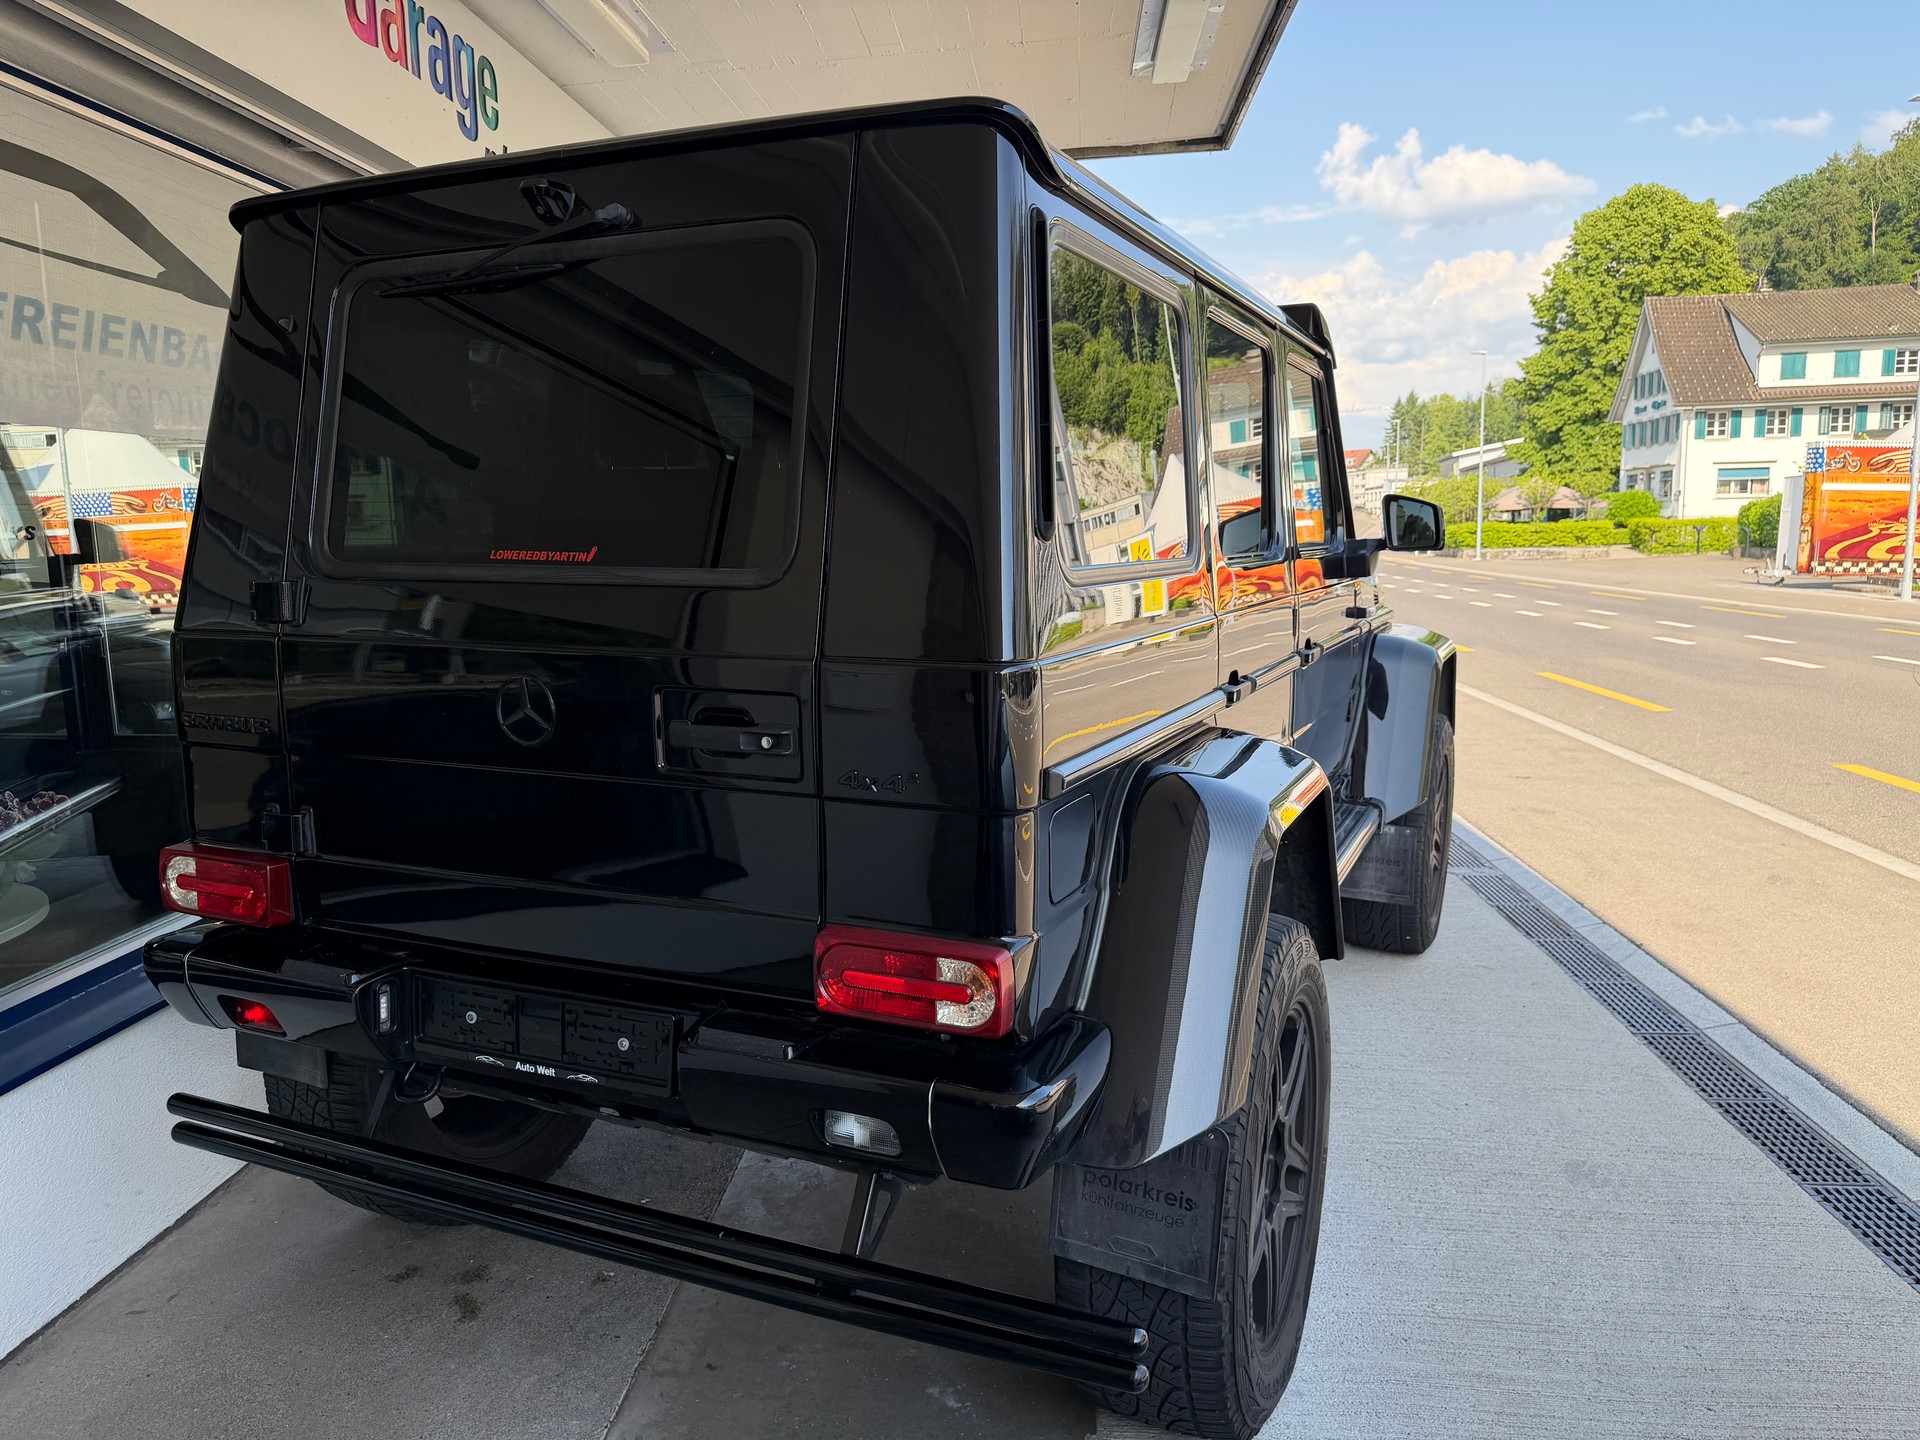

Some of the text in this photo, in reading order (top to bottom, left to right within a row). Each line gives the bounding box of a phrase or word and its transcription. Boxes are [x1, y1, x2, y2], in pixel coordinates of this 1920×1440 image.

[0, 291, 221, 373] REIENBA
[490, 549, 587, 562] LOWEREDBYARTIN
[515, 1061, 556, 1077] Auto Welt
[1083, 1169, 1195, 1212] polarkreis
